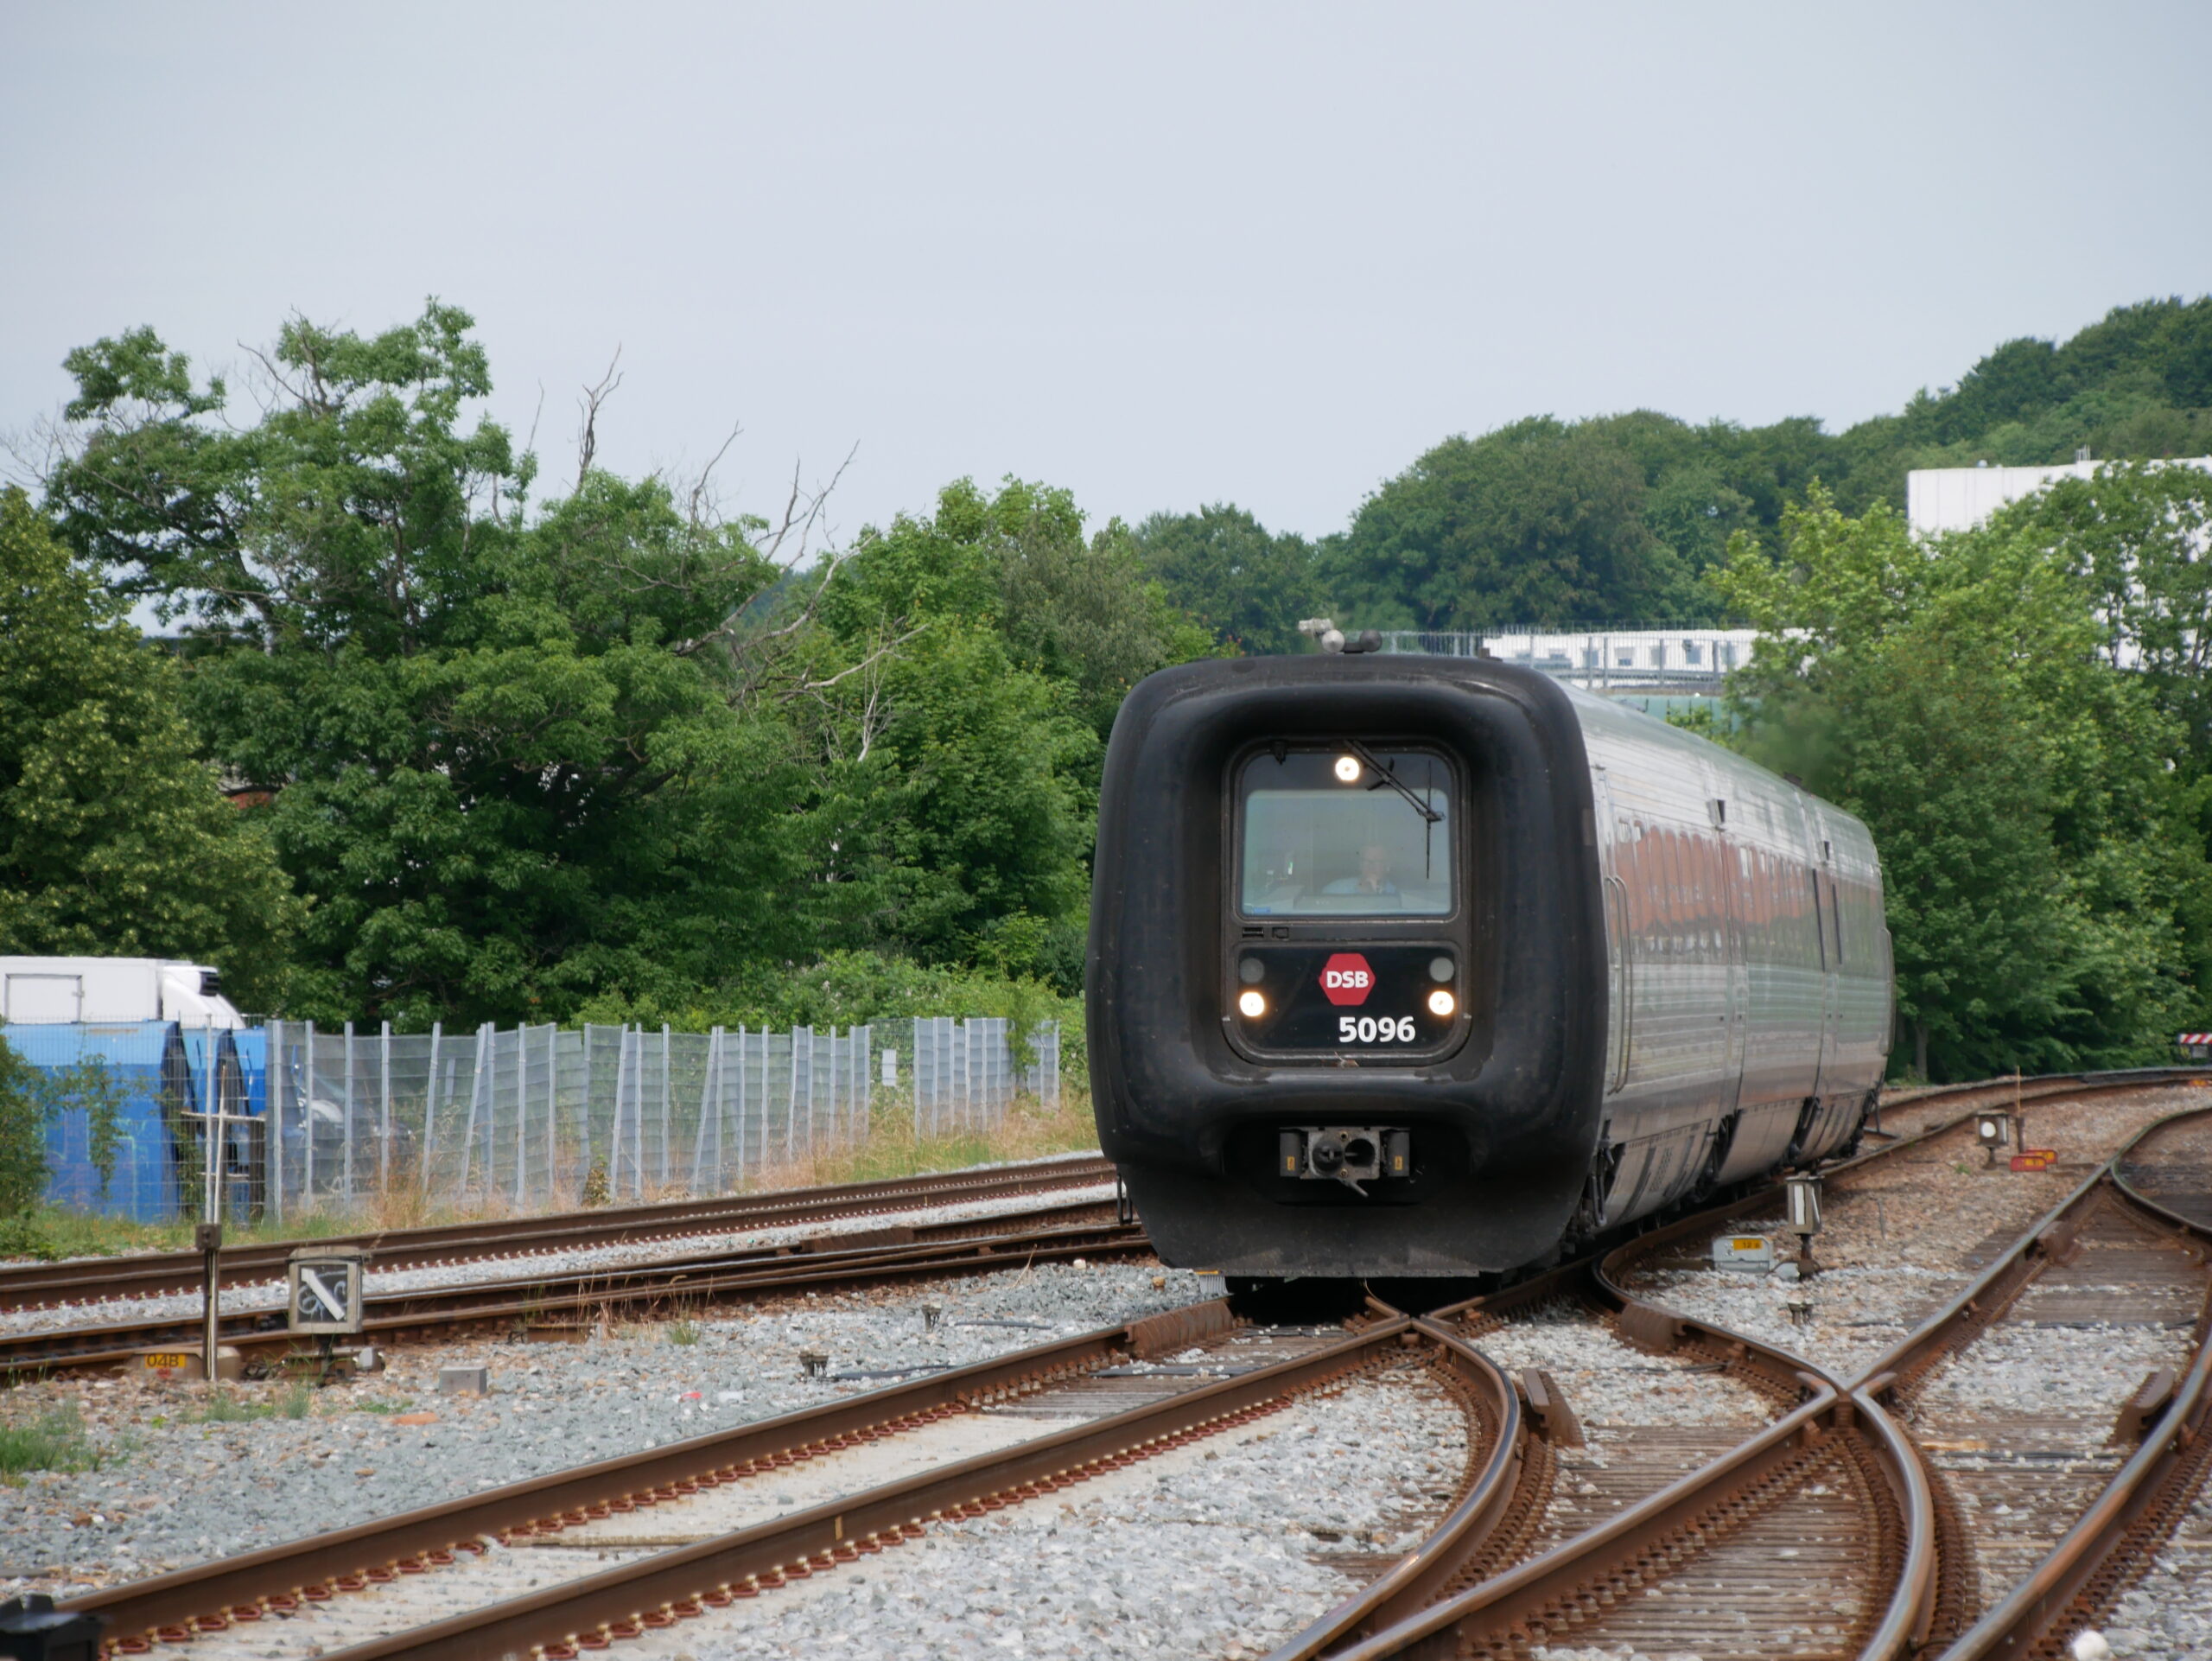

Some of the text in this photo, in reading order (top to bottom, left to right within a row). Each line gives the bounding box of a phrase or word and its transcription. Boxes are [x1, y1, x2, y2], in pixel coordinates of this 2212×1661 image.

[1327, 971, 1369, 988] DSB
[1339, 1016, 1416, 1042] 5096
[146, 1354, 179, 1368] 04B
